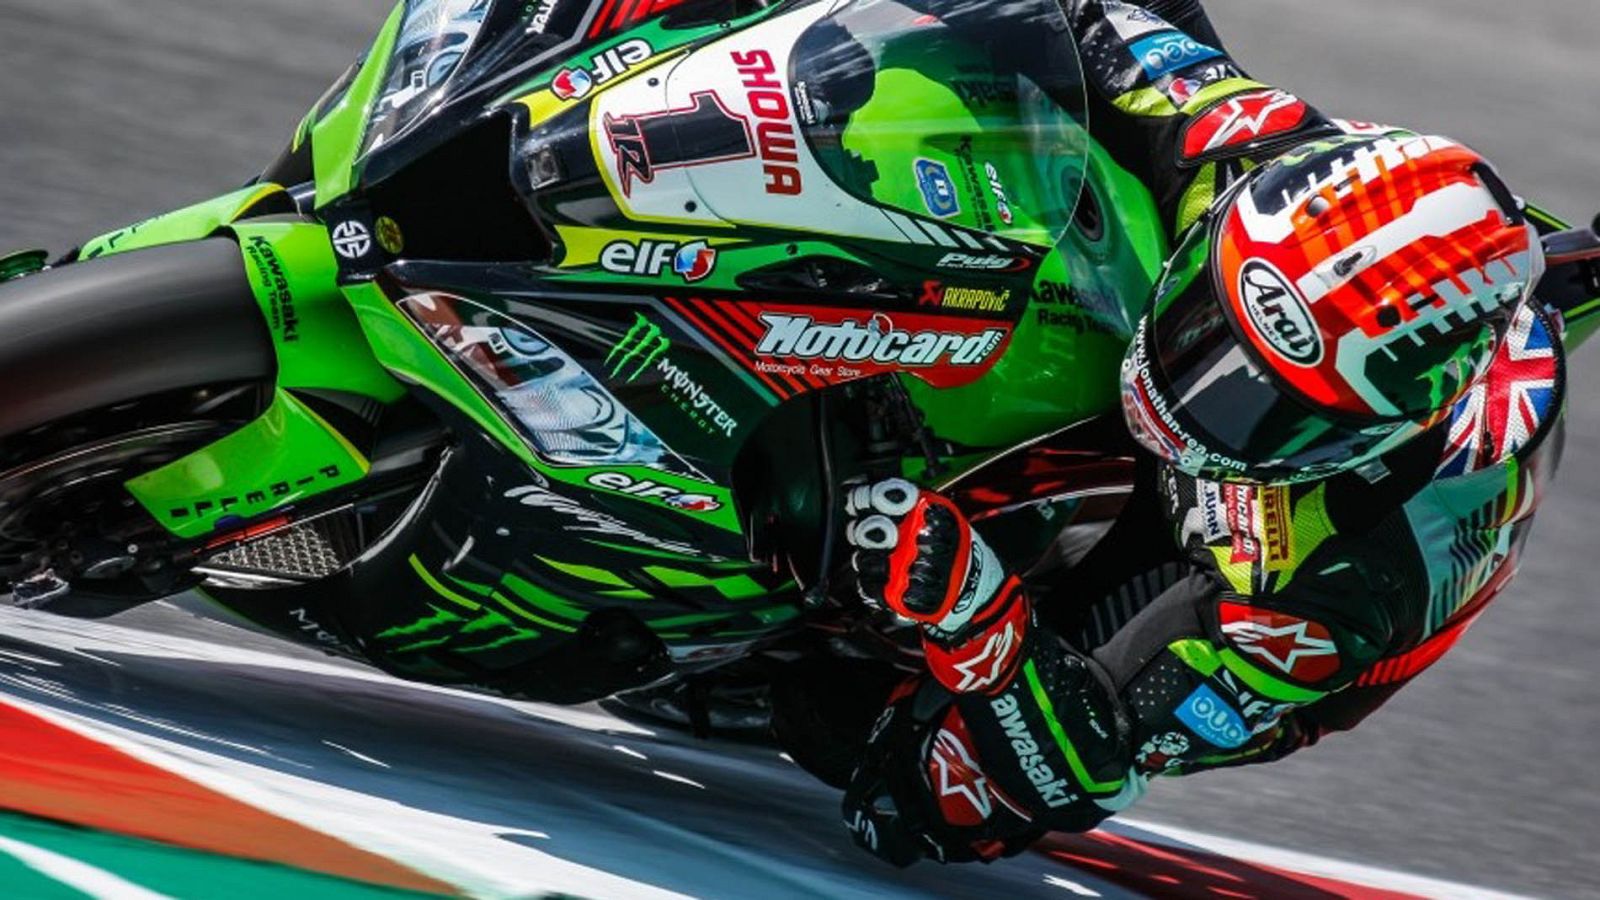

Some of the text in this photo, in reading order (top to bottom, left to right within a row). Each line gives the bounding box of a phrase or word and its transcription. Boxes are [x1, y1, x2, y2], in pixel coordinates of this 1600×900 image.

[592, 39, 651, 84] elf
[621, 89, 757, 171] 1
[730, 49, 802, 196] SHOWA
[246, 246, 272, 288] Racing
[248, 236, 299, 342] Kawasaki
[601, 242, 673, 275] elf
[936, 252, 1014, 269] Puig
[1244, 272, 1314, 353] Arai
[657, 357, 738, 437] MONSTER
[755, 361, 861, 377] Motorcycle Gear Store
[588, 472, 679, 498] elf
[990, 682, 1079, 808] awasaki
